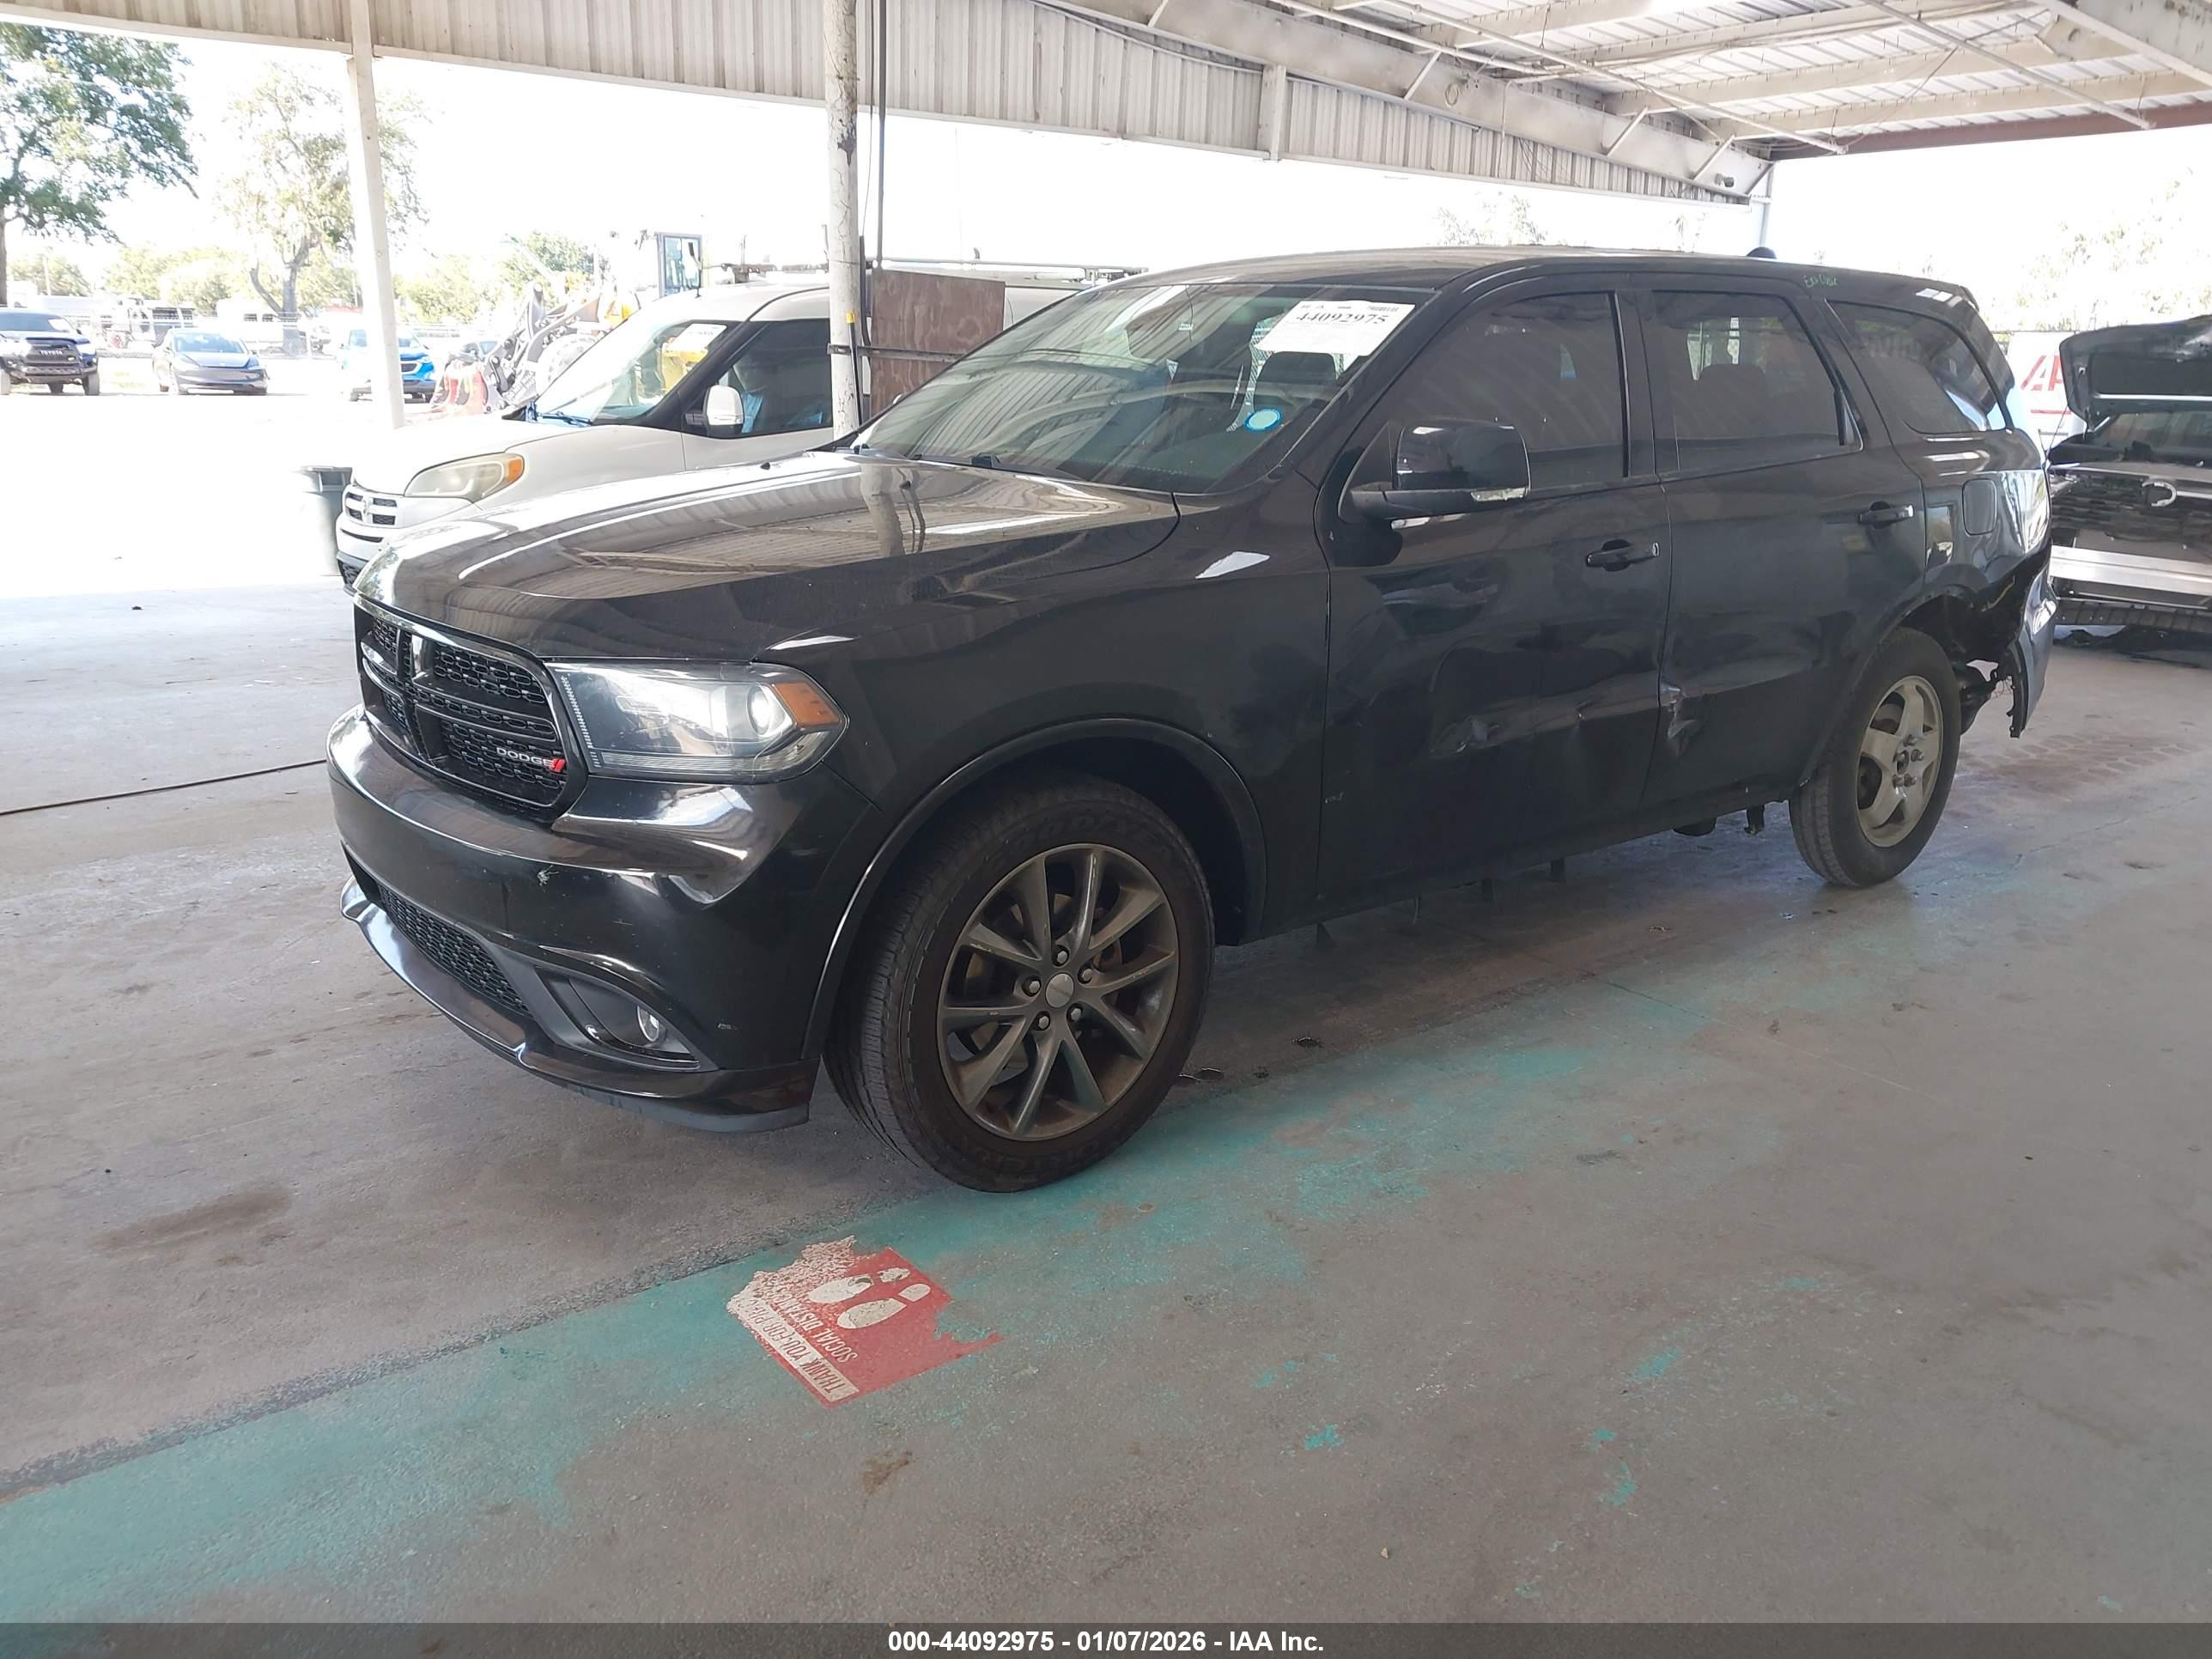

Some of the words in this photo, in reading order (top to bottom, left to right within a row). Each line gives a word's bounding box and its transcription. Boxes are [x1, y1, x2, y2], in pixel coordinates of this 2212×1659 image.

[1296, 312, 1389, 325] 44092975
[496, 746, 555, 769] DODGE
[763, 1322, 794, 1342] FOR
[780, 1337, 811, 1362] YOU
[812, 1328, 859, 1363] SOCIAL
[799, 1357, 846, 1394] THANK
